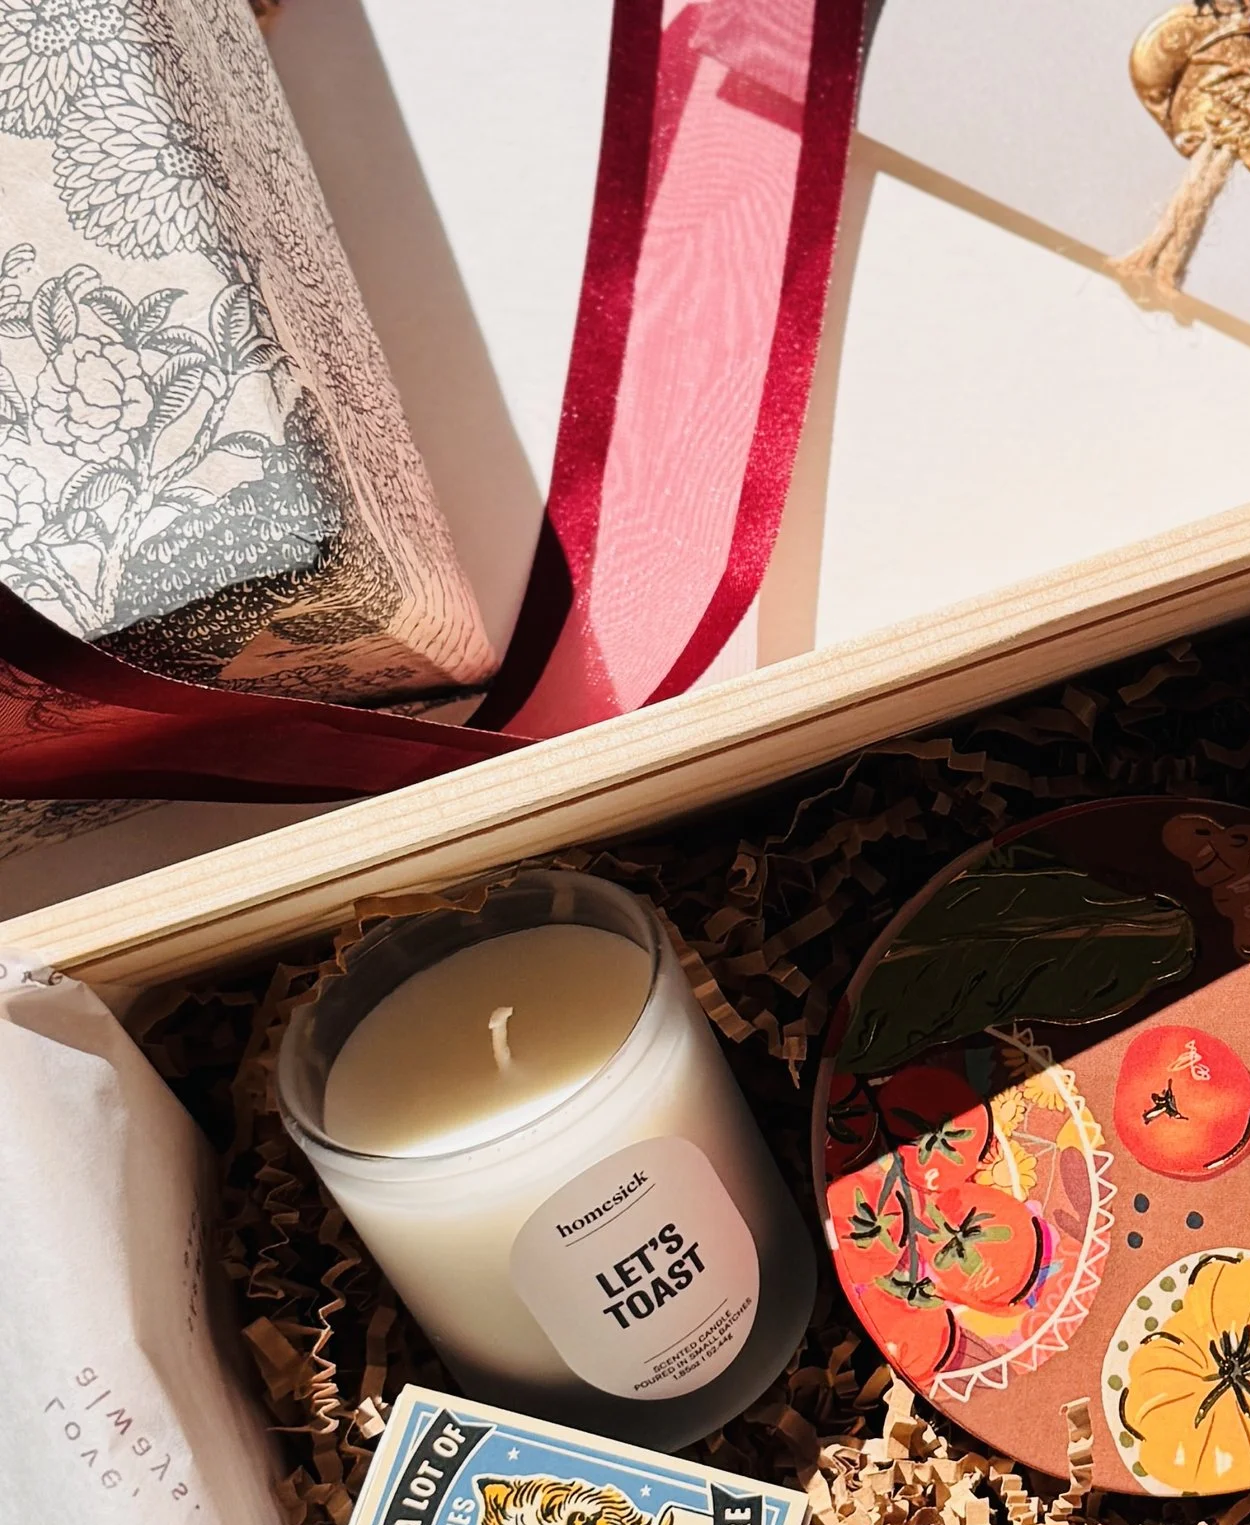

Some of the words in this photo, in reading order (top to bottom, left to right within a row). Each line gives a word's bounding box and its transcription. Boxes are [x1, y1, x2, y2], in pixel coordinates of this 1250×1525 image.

[556, 1169, 649, 1238] homesick
[595, 1223, 684, 1299] LET'S
[603, 1242, 706, 1329] TOAST
[634, 1365, 676, 1391] POURED
[677, 1357, 688, 1369] IN
[688, 1336, 719, 1362] SMALL
[653, 1341, 698, 1373] SCENTED
[698, 1309, 732, 1344] CANDLE
[410, 1456, 446, 1511] LOT
[434, 1421, 468, 1468] OF
